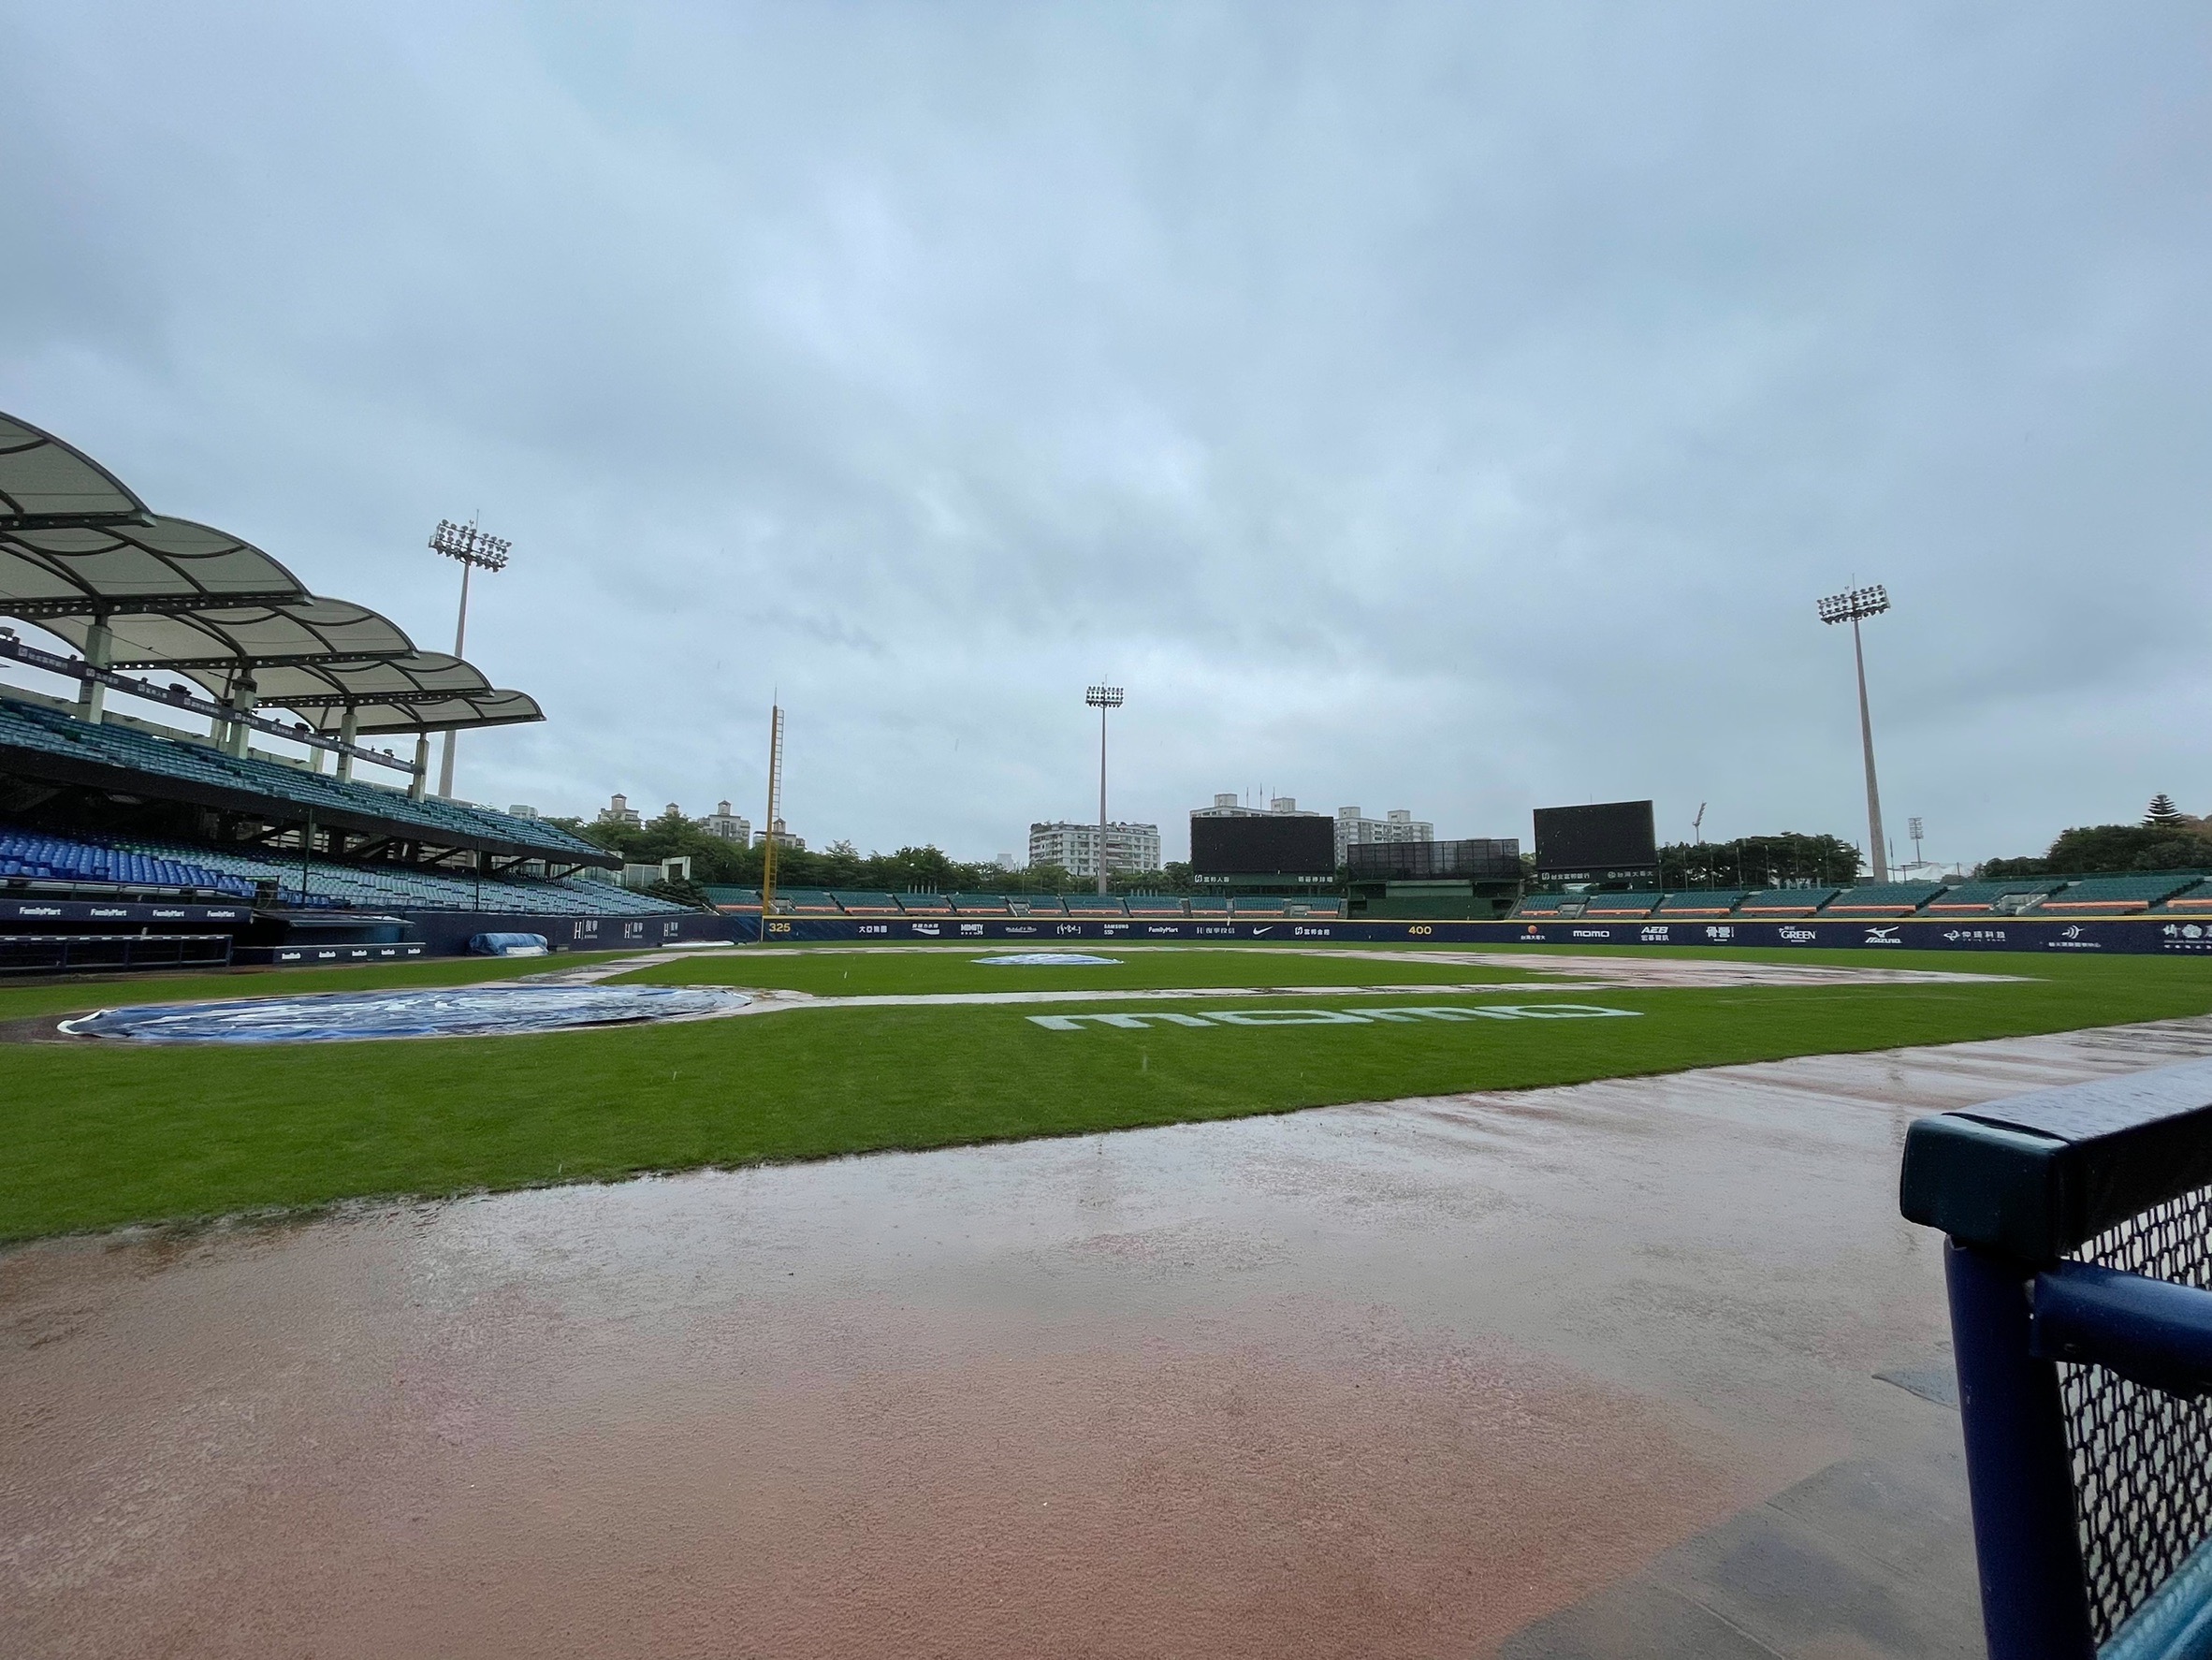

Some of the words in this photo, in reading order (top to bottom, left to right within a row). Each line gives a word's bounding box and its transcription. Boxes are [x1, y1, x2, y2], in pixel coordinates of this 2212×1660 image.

[19, 907, 62, 916] FamilyMart
[91, 908, 127, 917] FamilyMart
[153, 909, 185, 918] FamilyMart
[207, 910, 236, 918] FamilyMart
[768, 923, 792, 933] 325
[1408, 925, 1433, 935] 400
[1781, 930, 1816, 939] GREEN
[1026, 1004, 1644, 1029] momo
